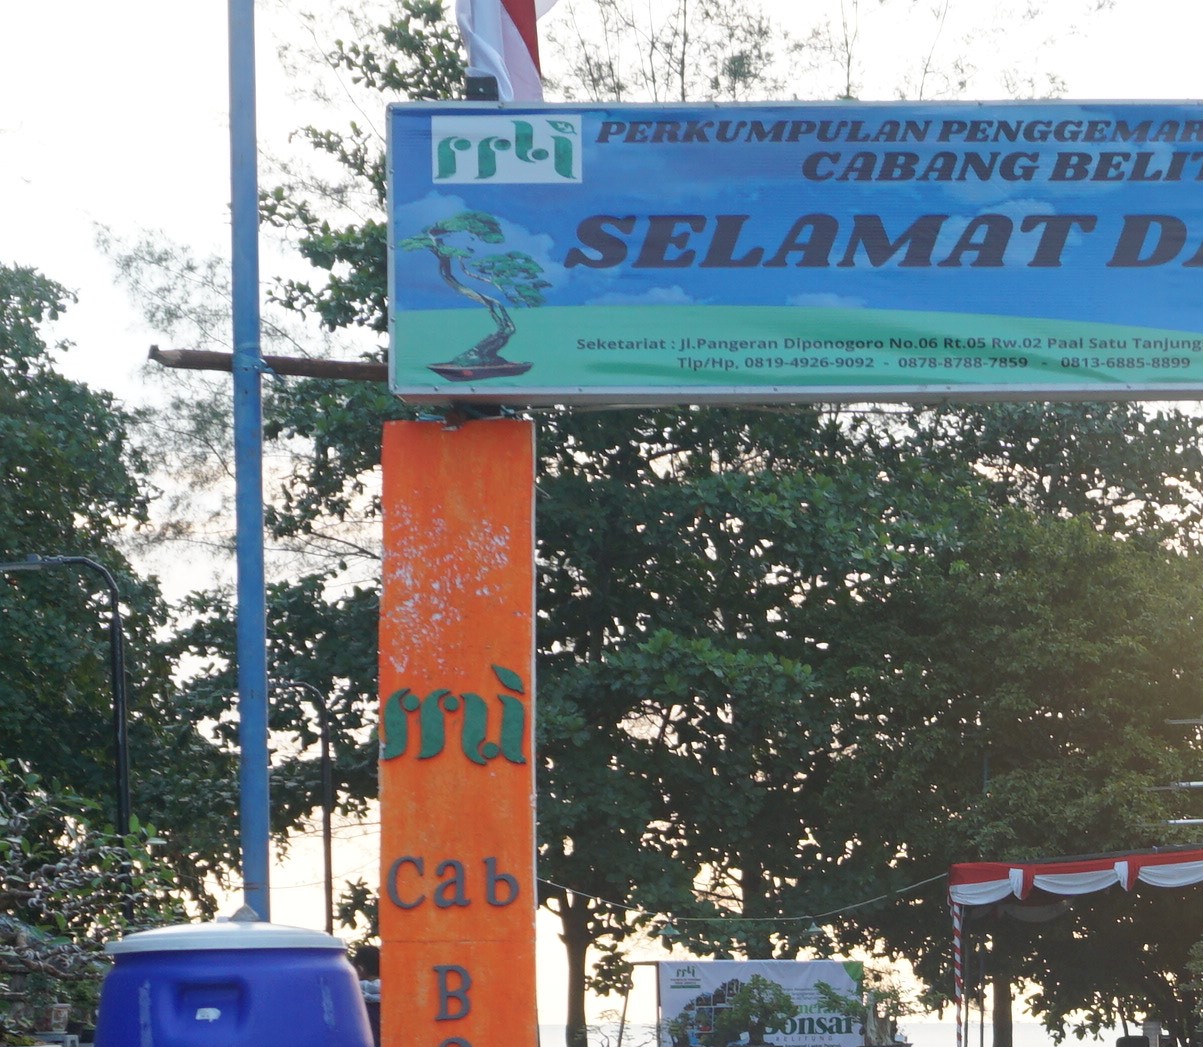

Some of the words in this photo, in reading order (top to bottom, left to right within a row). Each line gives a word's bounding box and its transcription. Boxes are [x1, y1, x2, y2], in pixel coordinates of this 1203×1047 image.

[595, 119, 933, 144] PERKUMPULAN
[802, 151, 1040, 182] CABANG
[563, 213, 1098, 269] SELAMAT
[576, 336, 667, 351] Seketariat
[783, 336, 885, 354] Diponogoro
[889, 336, 939, 350] No.06
[942, 336, 987, 349] Rt.05
[991, 336, 1042, 349] Rw.02
[1046, 336, 1084, 349] Paal
[1088, 336, 1129, 349] Satu
[744, 356, 875, 369] 0819-4926-9092
[898, 356, 1029, 369] 0878-8788-7859
[1060, 356, 1191, 369] 0813-6885-8899
[386, 855, 520, 910] Cab
